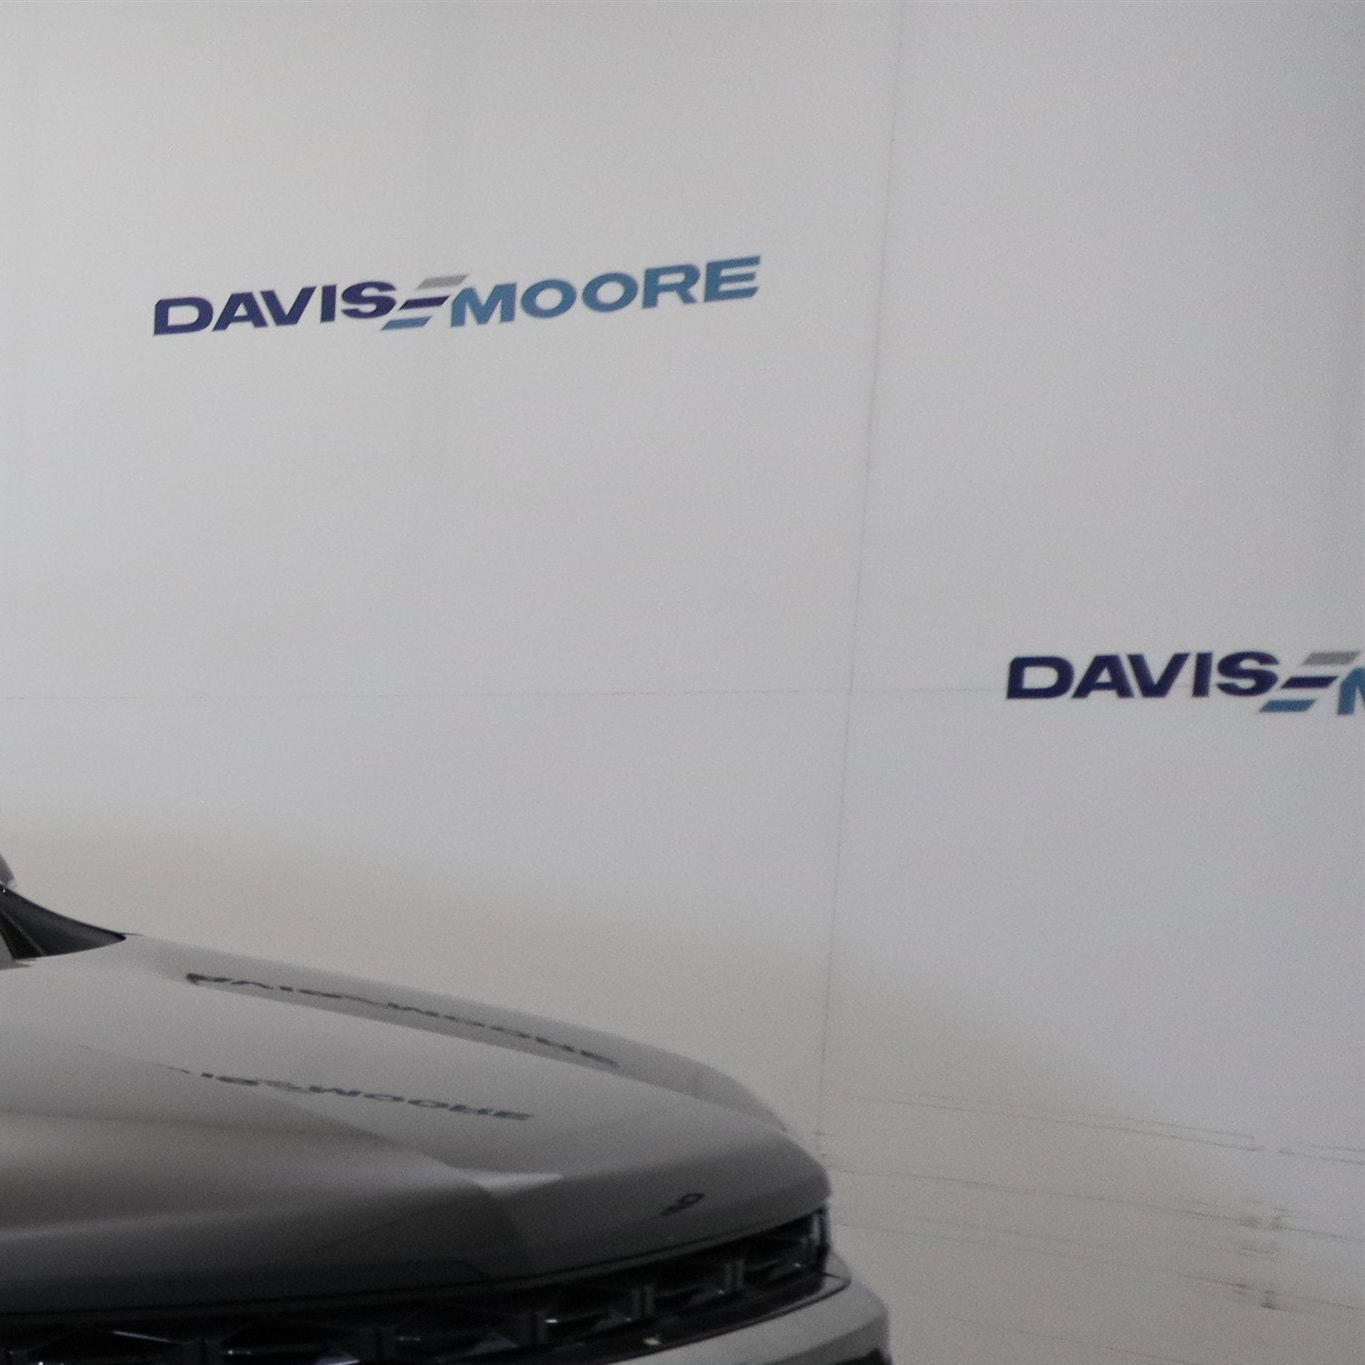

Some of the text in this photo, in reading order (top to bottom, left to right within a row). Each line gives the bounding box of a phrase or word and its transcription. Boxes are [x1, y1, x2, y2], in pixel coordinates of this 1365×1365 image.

[153, 256, 761, 335] DAVIS MOORE
[1006, 651, 1281, 700] DAVIS
